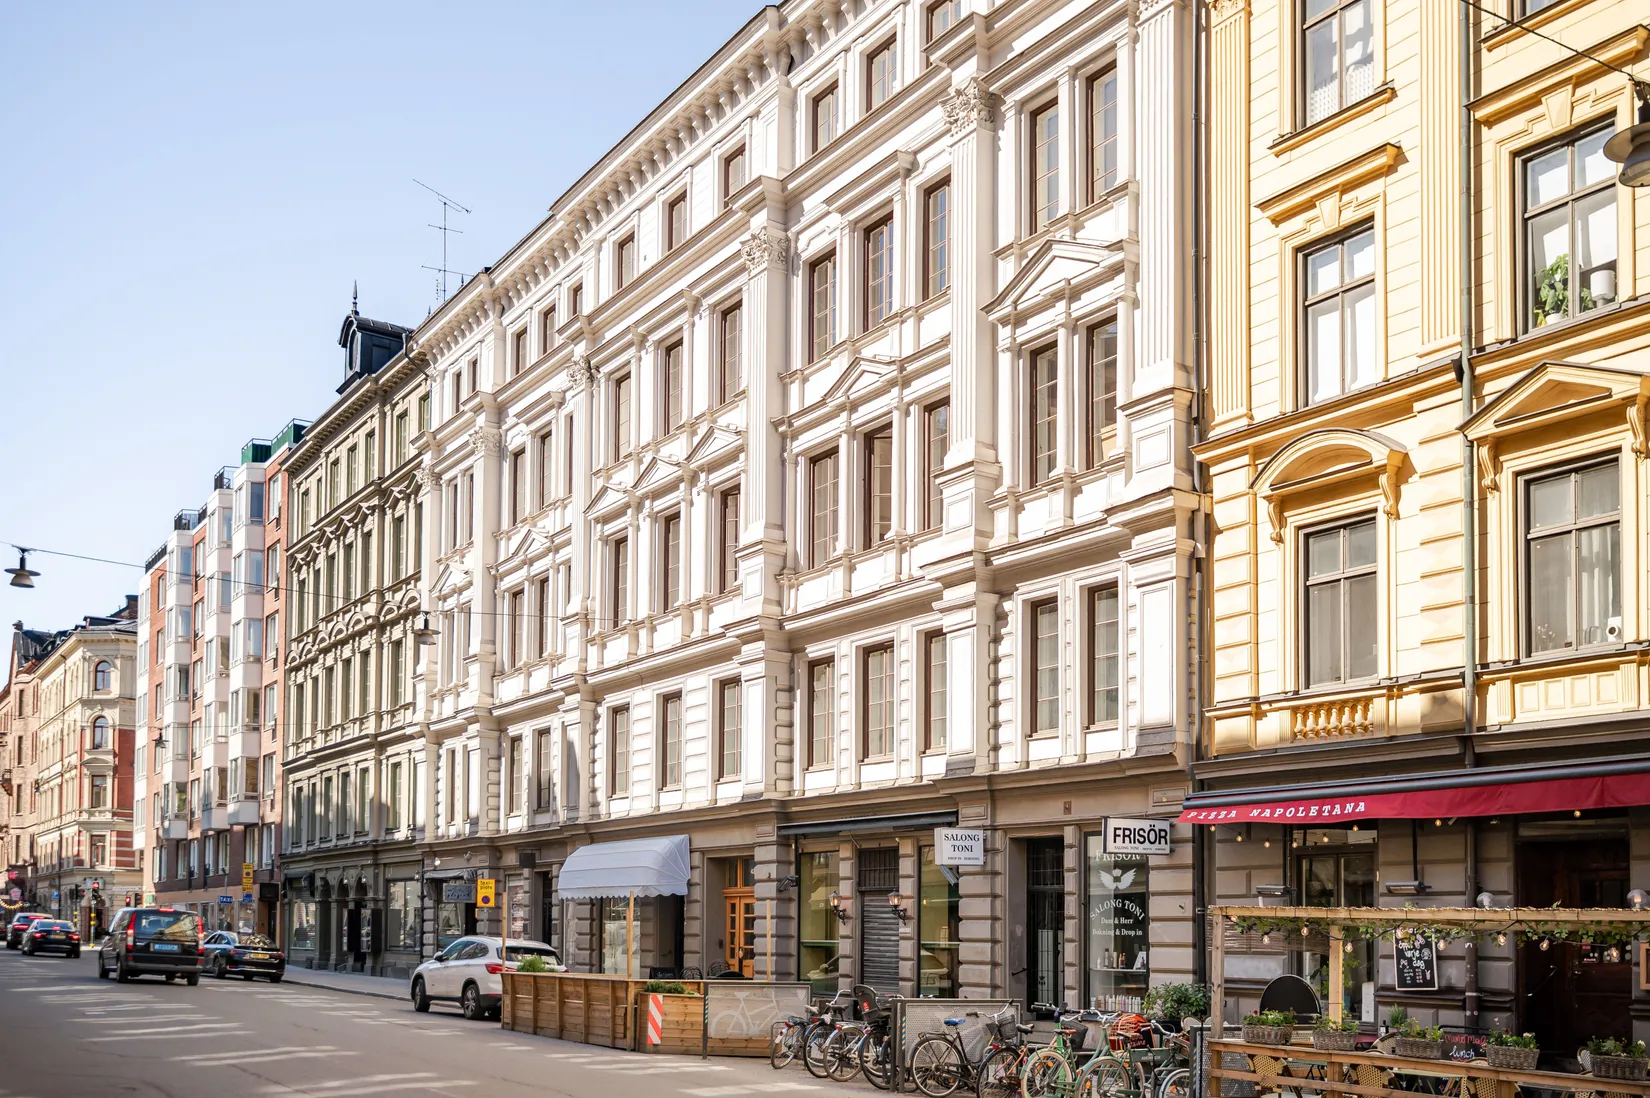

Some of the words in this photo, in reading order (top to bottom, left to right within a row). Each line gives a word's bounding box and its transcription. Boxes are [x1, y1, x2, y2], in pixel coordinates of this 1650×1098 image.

[1187, 810, 1237, 819] PIZZA
[1249, 802, 1366, 818] NAPOLETANA
[944, 833, 980, 842] SALONG
[1113, 823, 1168, 846] FRISÖR
[951, 844, 974, 853] TONI
[1090, 899, 1122, 921] SALONG
[1124, 900, 1145, 921] TONI
[1092, 928, 1114, 937] Bokning
[1121, 929, 1135, 937] Drop
[1449, 1045, 1475, 1059] lunch
